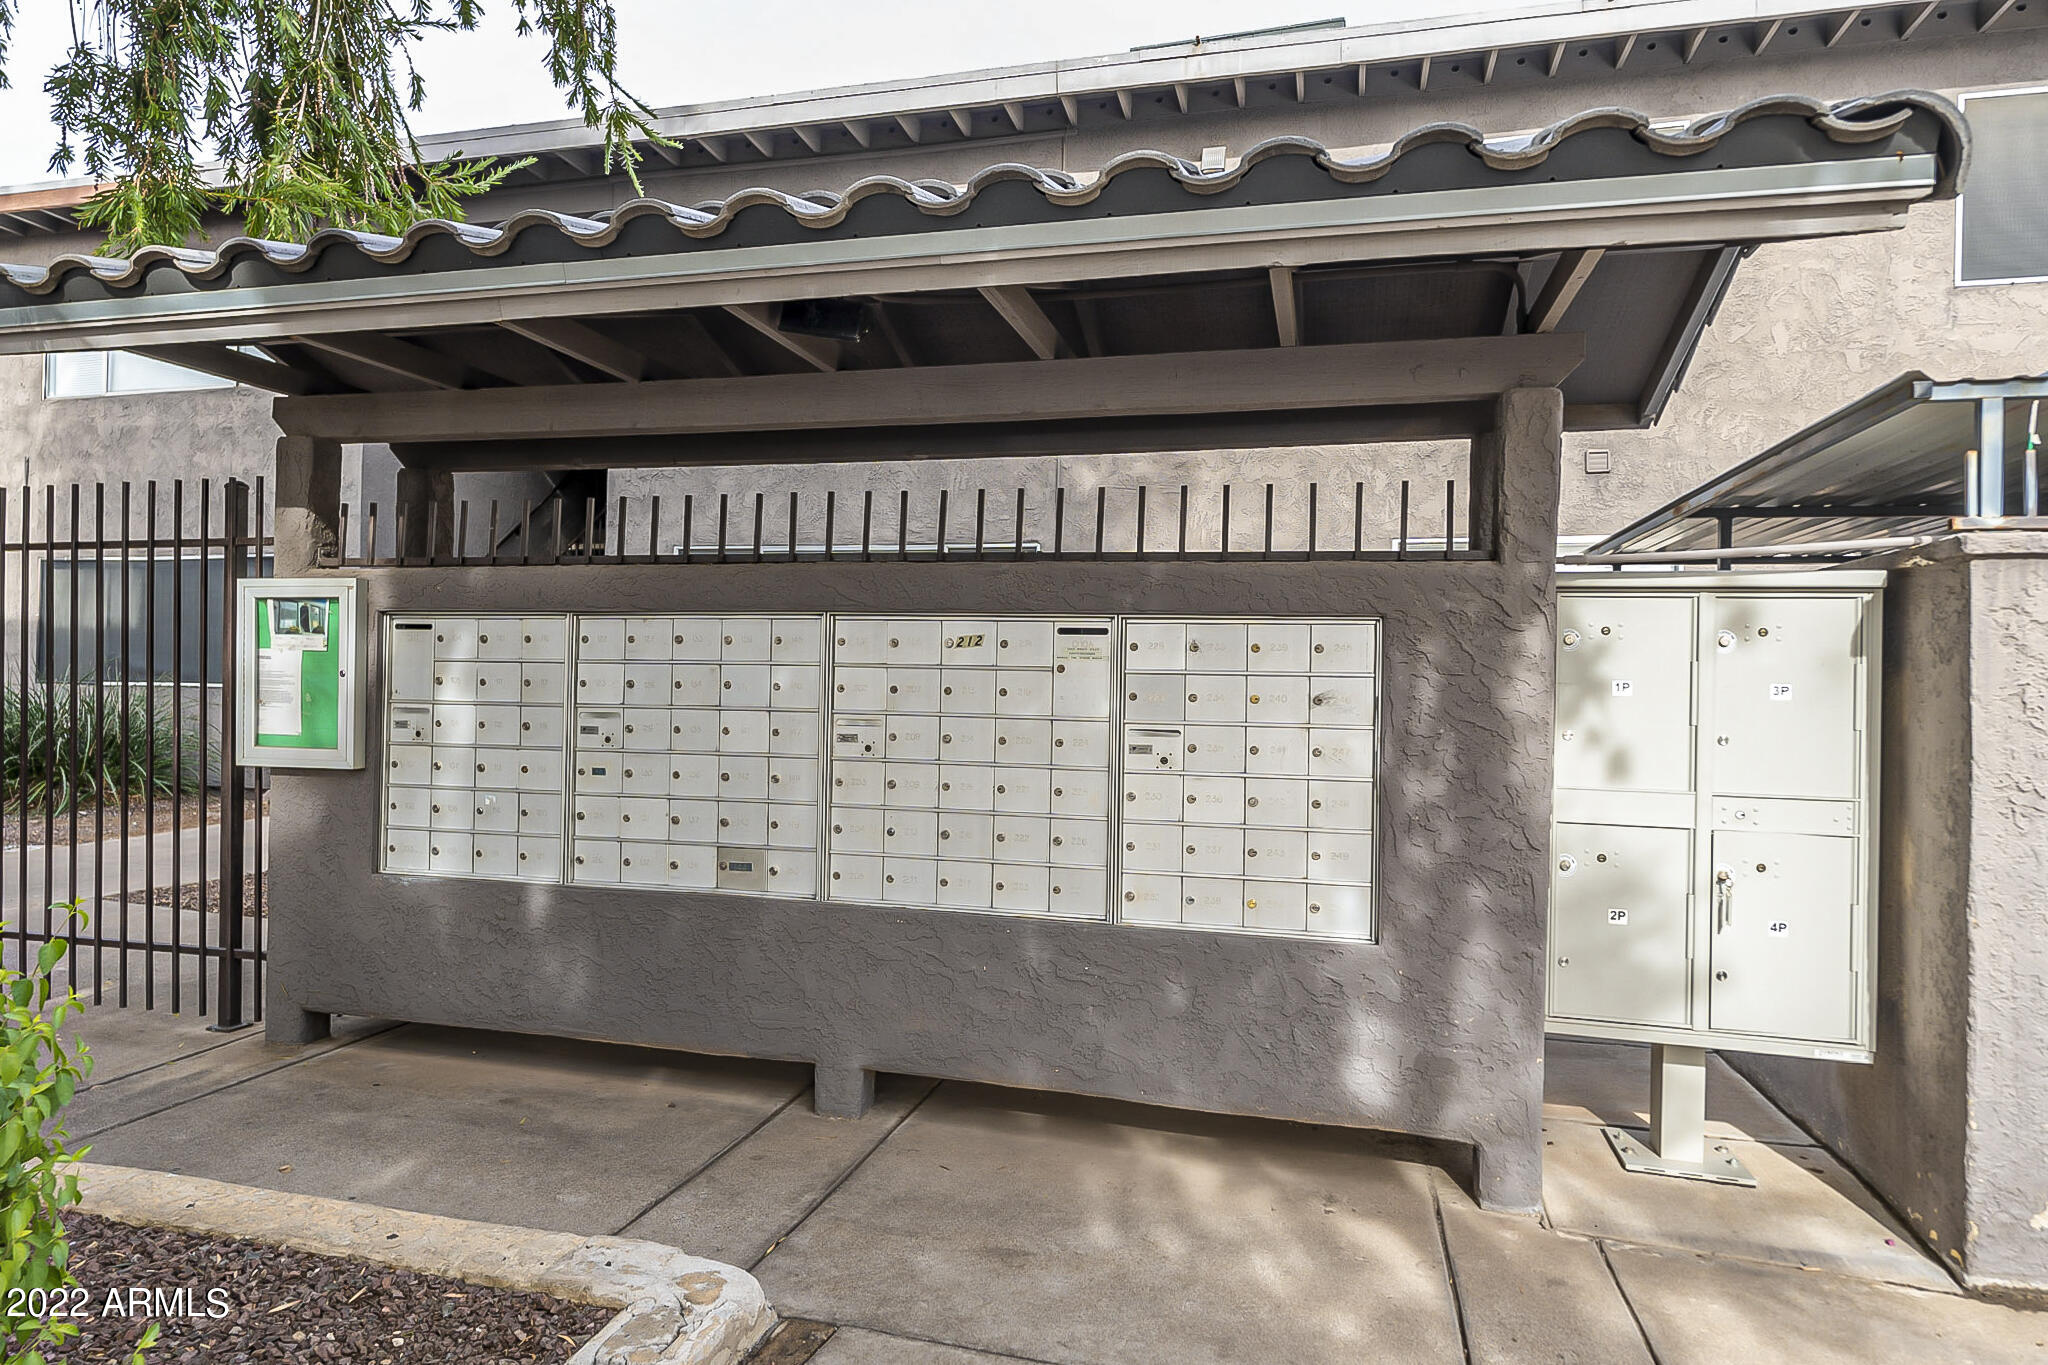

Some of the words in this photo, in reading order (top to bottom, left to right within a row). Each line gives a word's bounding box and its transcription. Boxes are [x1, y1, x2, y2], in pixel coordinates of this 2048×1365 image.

[957, 635, 982, 648] 212
[1616, 683, 1630, 691] 1P
[1773, 686, 1790, 695] 3P
[1610, 911, 1626, 920] 2P
[1770, 923, 1787, 932] 4P
